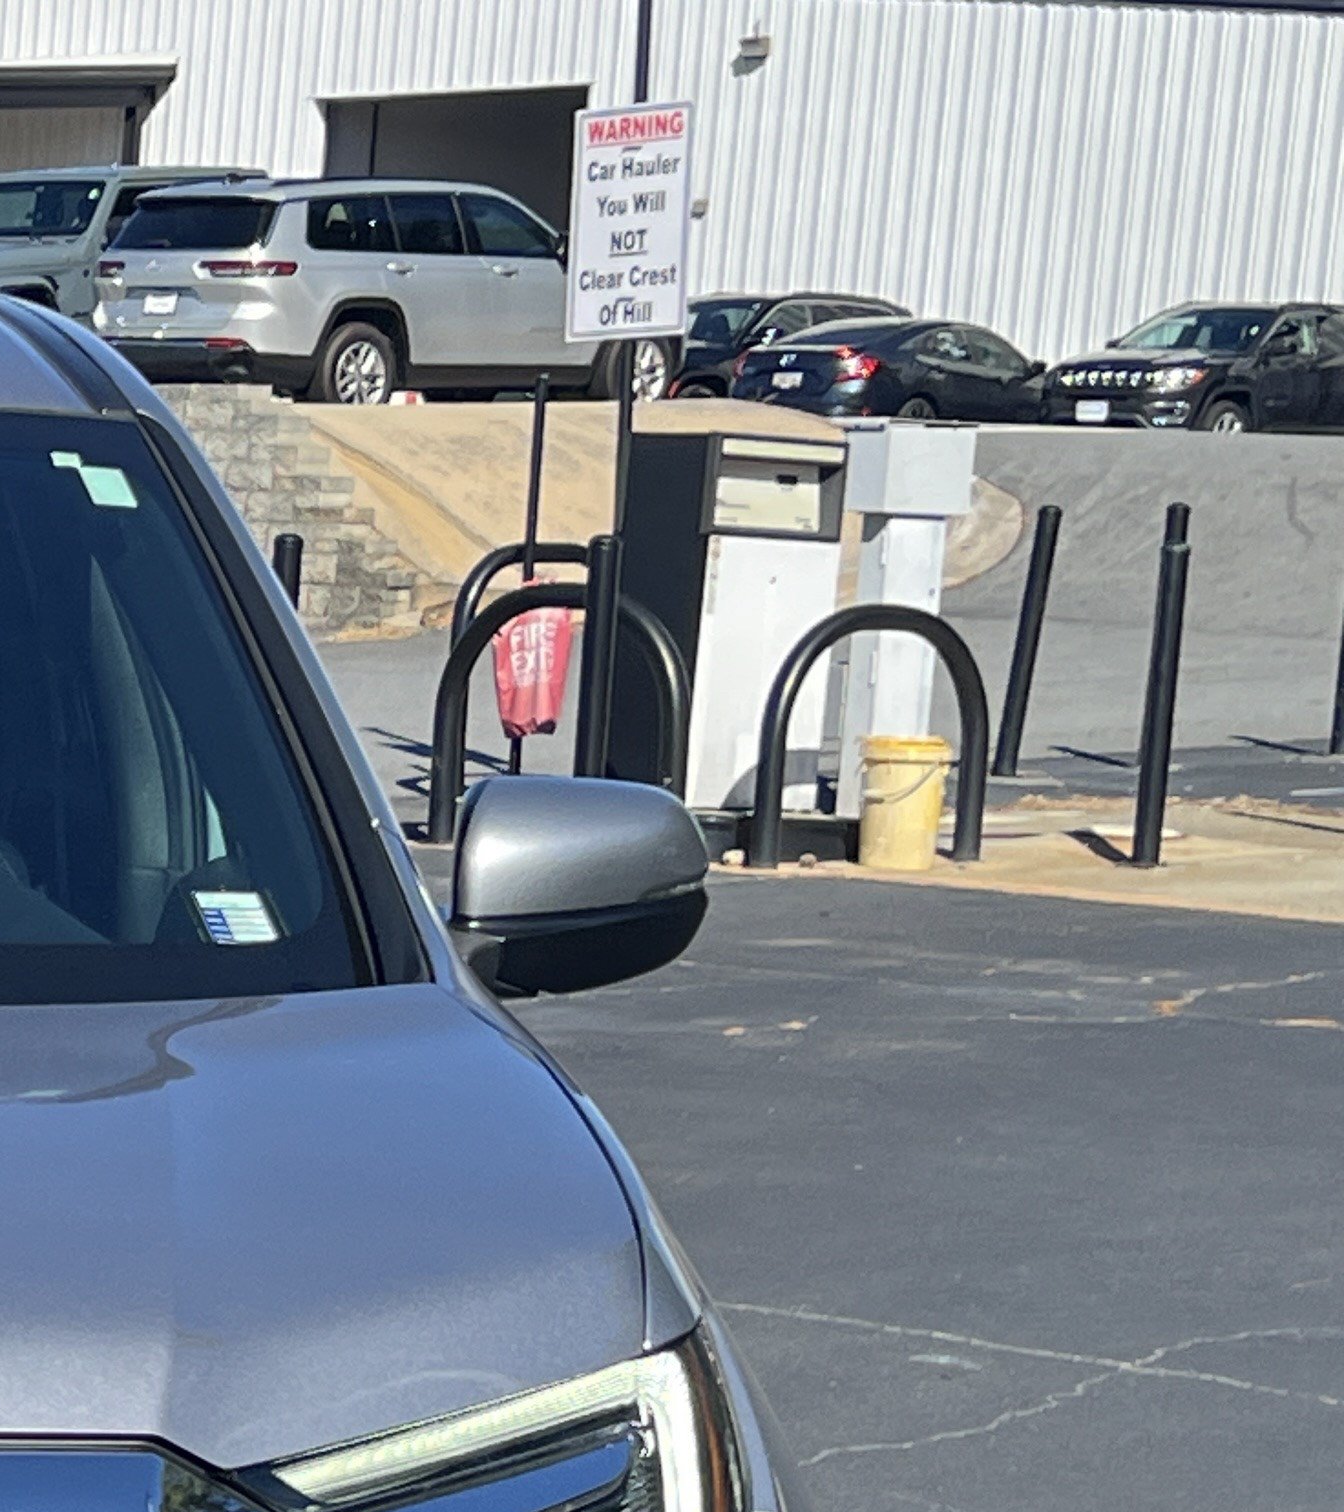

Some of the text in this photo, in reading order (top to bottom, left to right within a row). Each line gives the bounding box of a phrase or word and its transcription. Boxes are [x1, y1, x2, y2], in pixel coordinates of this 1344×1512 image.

[587, 111, 684, 143] WARNING
[587, 156, 681, 182] Car Hauler
[596, 190, 666, 217] You Will
[610, 229, 648, 251] NOT
[579, 264, 677, 291] Clear Crest
[599, 301, 653, 326] Of Hill
[509, 622, 557, 653] FIRE
